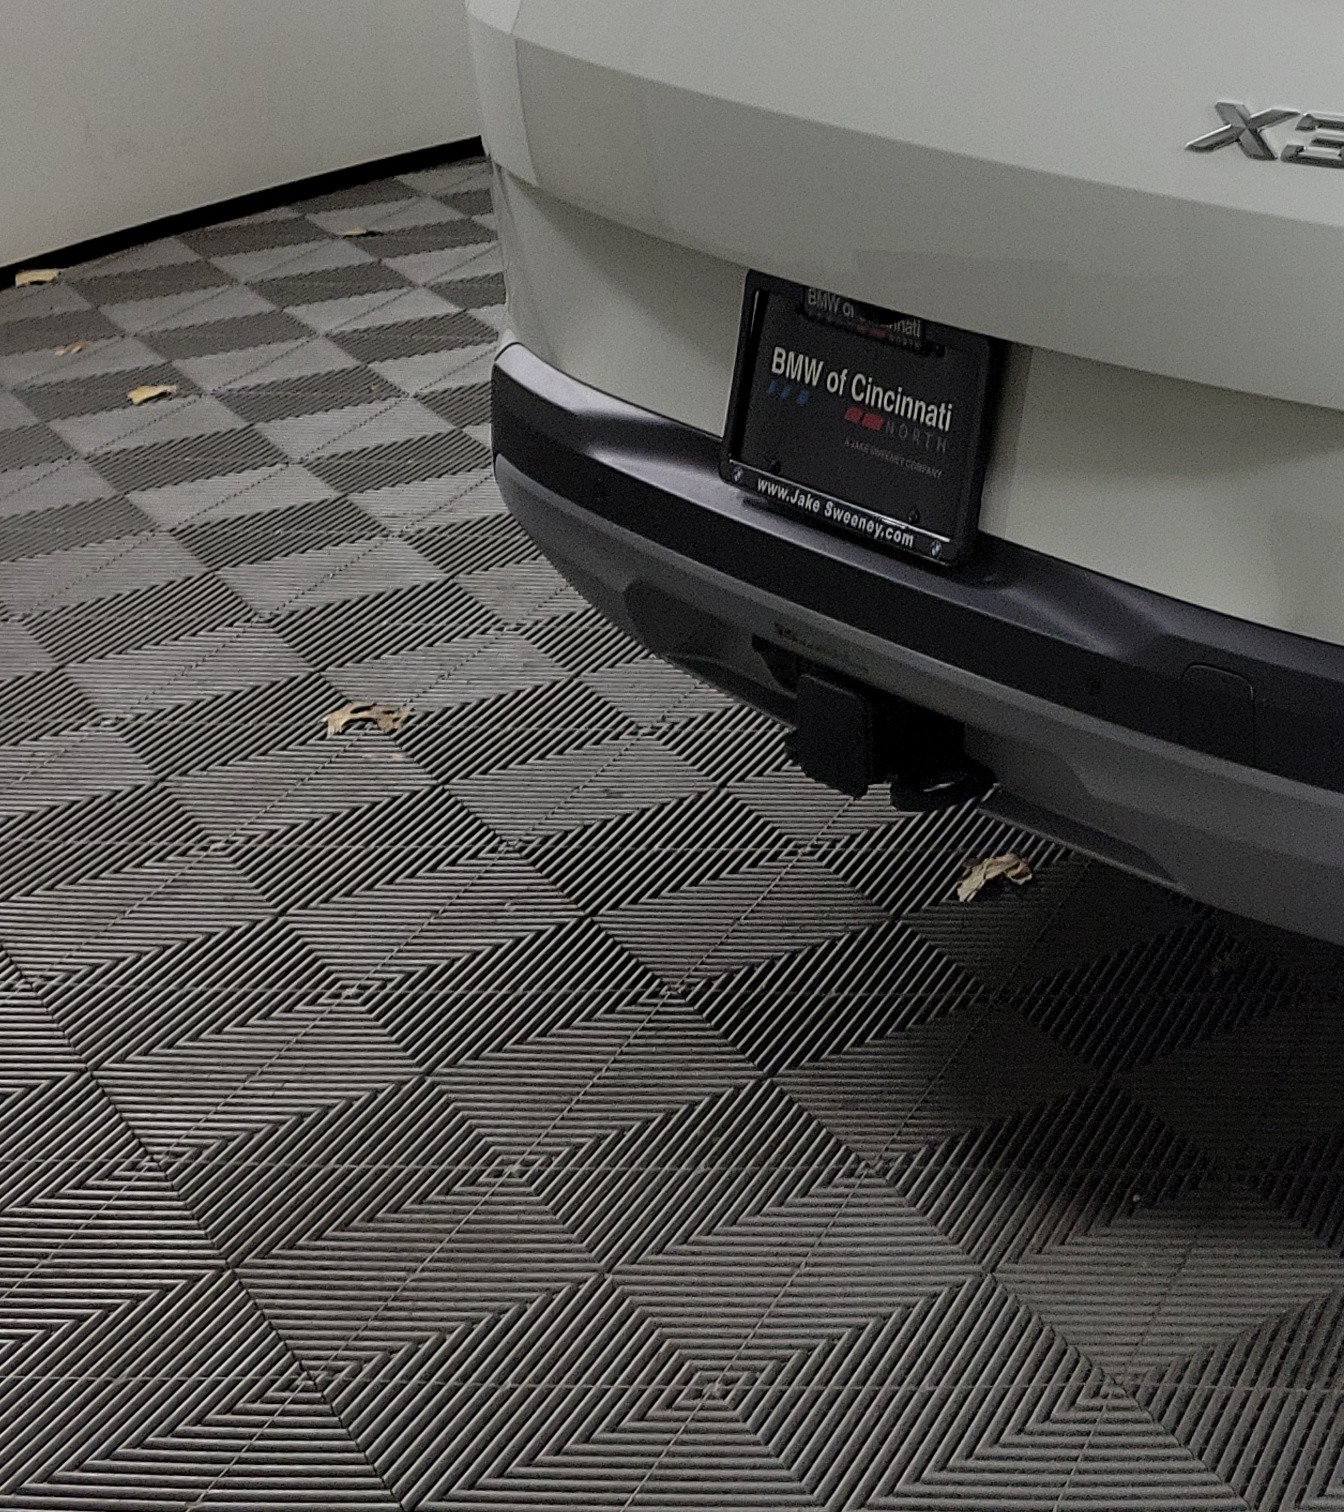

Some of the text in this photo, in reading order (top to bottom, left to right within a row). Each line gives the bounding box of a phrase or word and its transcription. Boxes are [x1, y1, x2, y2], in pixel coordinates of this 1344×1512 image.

[771, 345, 953, 433] BMW of Cincinnati
[823, 501, 914, 547] Sweeney.com
